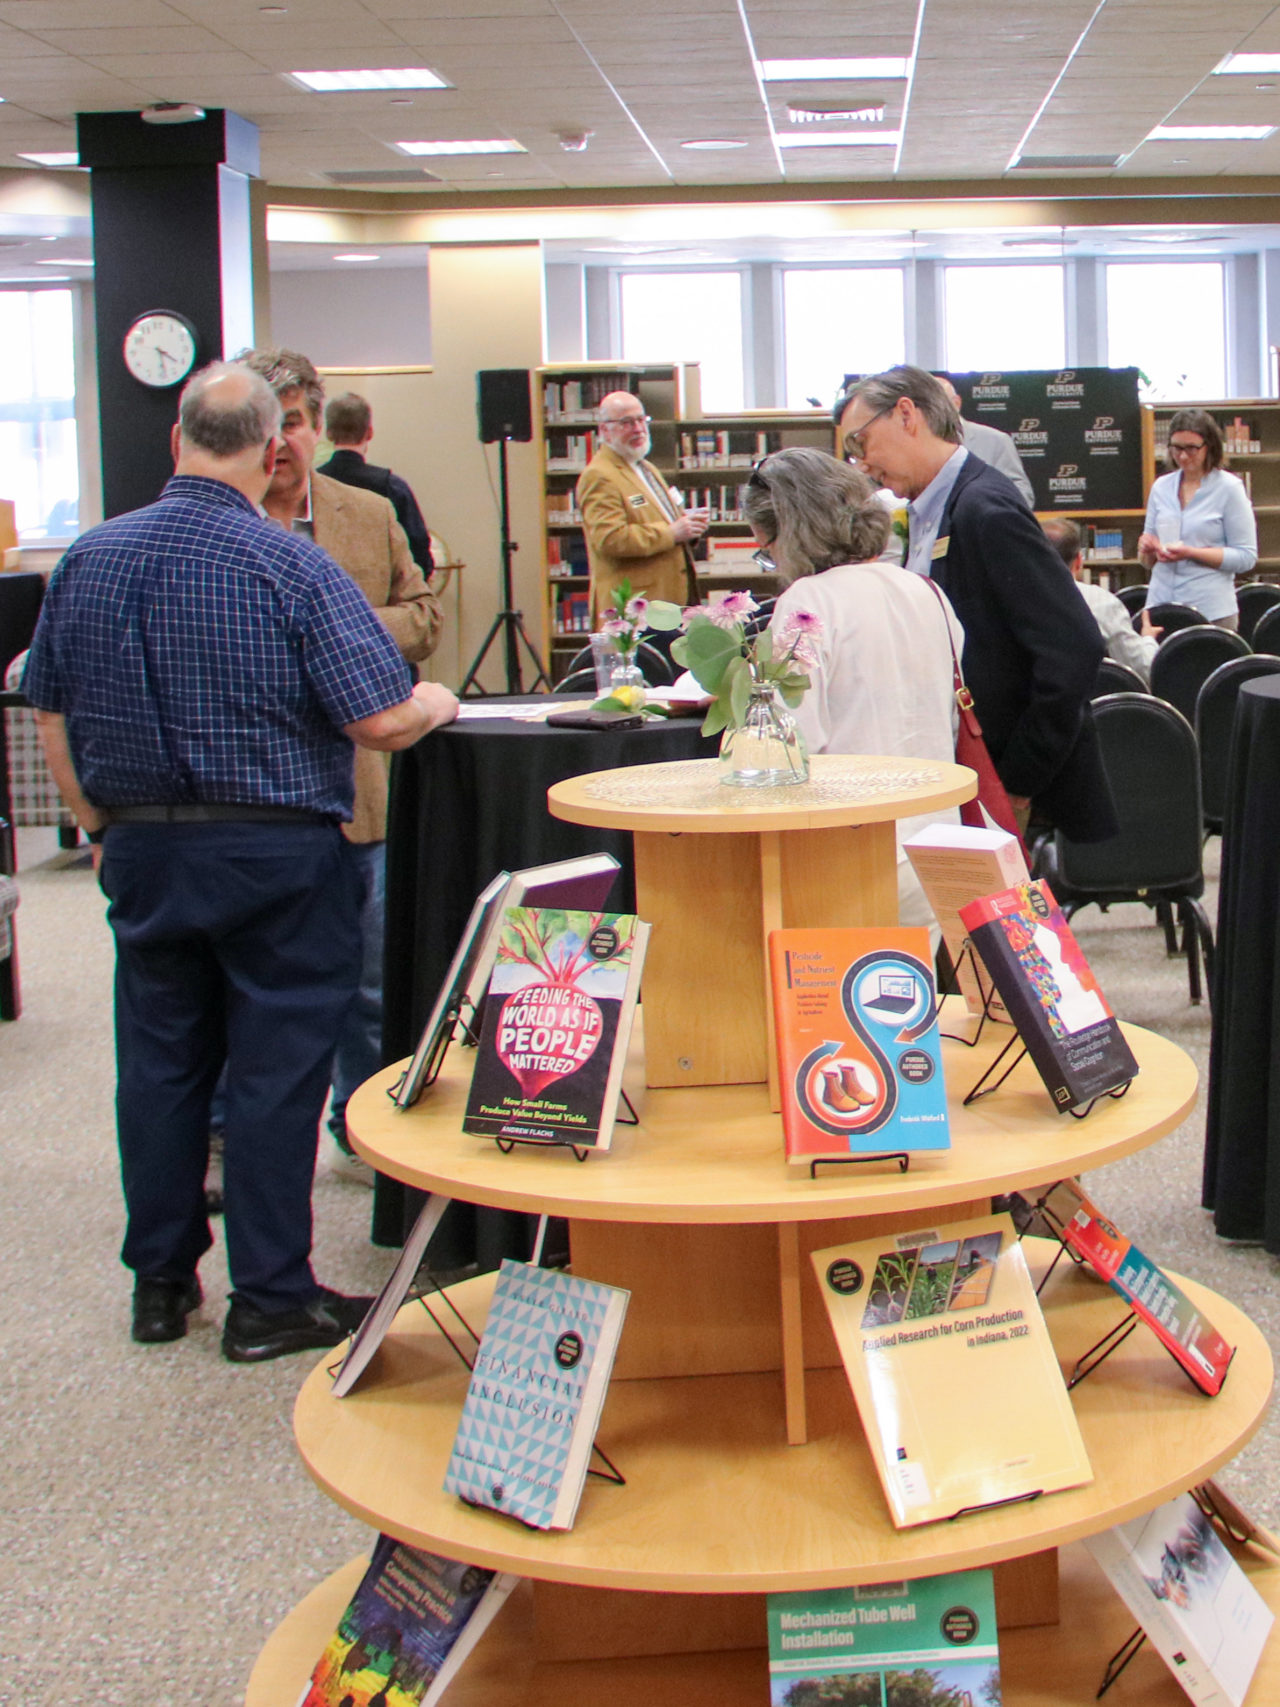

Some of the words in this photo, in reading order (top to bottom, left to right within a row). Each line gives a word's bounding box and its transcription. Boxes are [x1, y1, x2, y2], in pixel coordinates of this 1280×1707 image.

[972, 386, 1010, 394] PURDUE
[1047, 384, 1084, 392] PURDUE
[1085, 430, 1122, 438] PURDUE
[1049, 478, 1086, 486] PURDUE
[513, 987, 570, 1005] FEEDING
[572, 993, 593, 1009] THE
[502, 1005, 556, 1026] WORLD
[560, 1008, 580, 1028] AS
[585, 1012, 600, 1031] IF
[500, 1028, 597, 1060] PEOPLE
[509, 1053, 576, 1074] MATTERED
[503, 1096, 521, 1107] How
[522, 1099, 543, 1109] Small
[544, 1101, 568, 1111] Farms
[480, 1105, 510, 1117] Produce
[512, 1108, 533, 1119] Value
[534, 1110, 562, 1122] Beyond
[563, 1113, 587, 1124] Yields
[501, 1125, 528, 1136] ANDREW
[529, 1128, 554, 1137] FLACHS
[898, 1325, 939, 1343] Research
[940, 1321, 952, 1335] for
[954, 1318, 975, 1333] Corn
[976, 1309, 1024, 1329] Production
[967, 1335, 975, 1347] in
[976, 1329, 1008, 1346] Indiana,
[1009, 1325, 1030, 1340] 2022
[478, 1353, 585, 1399] FINANCIAL
[469, 1382, 576, 1428] INCLUSION
[780, 1607, 856, 1630] Mechanized
[857, 1606, 888, 1624] Tube
[889, 1603, 916, 1621] Well
[781, 1630, 855, 1650] Installation
